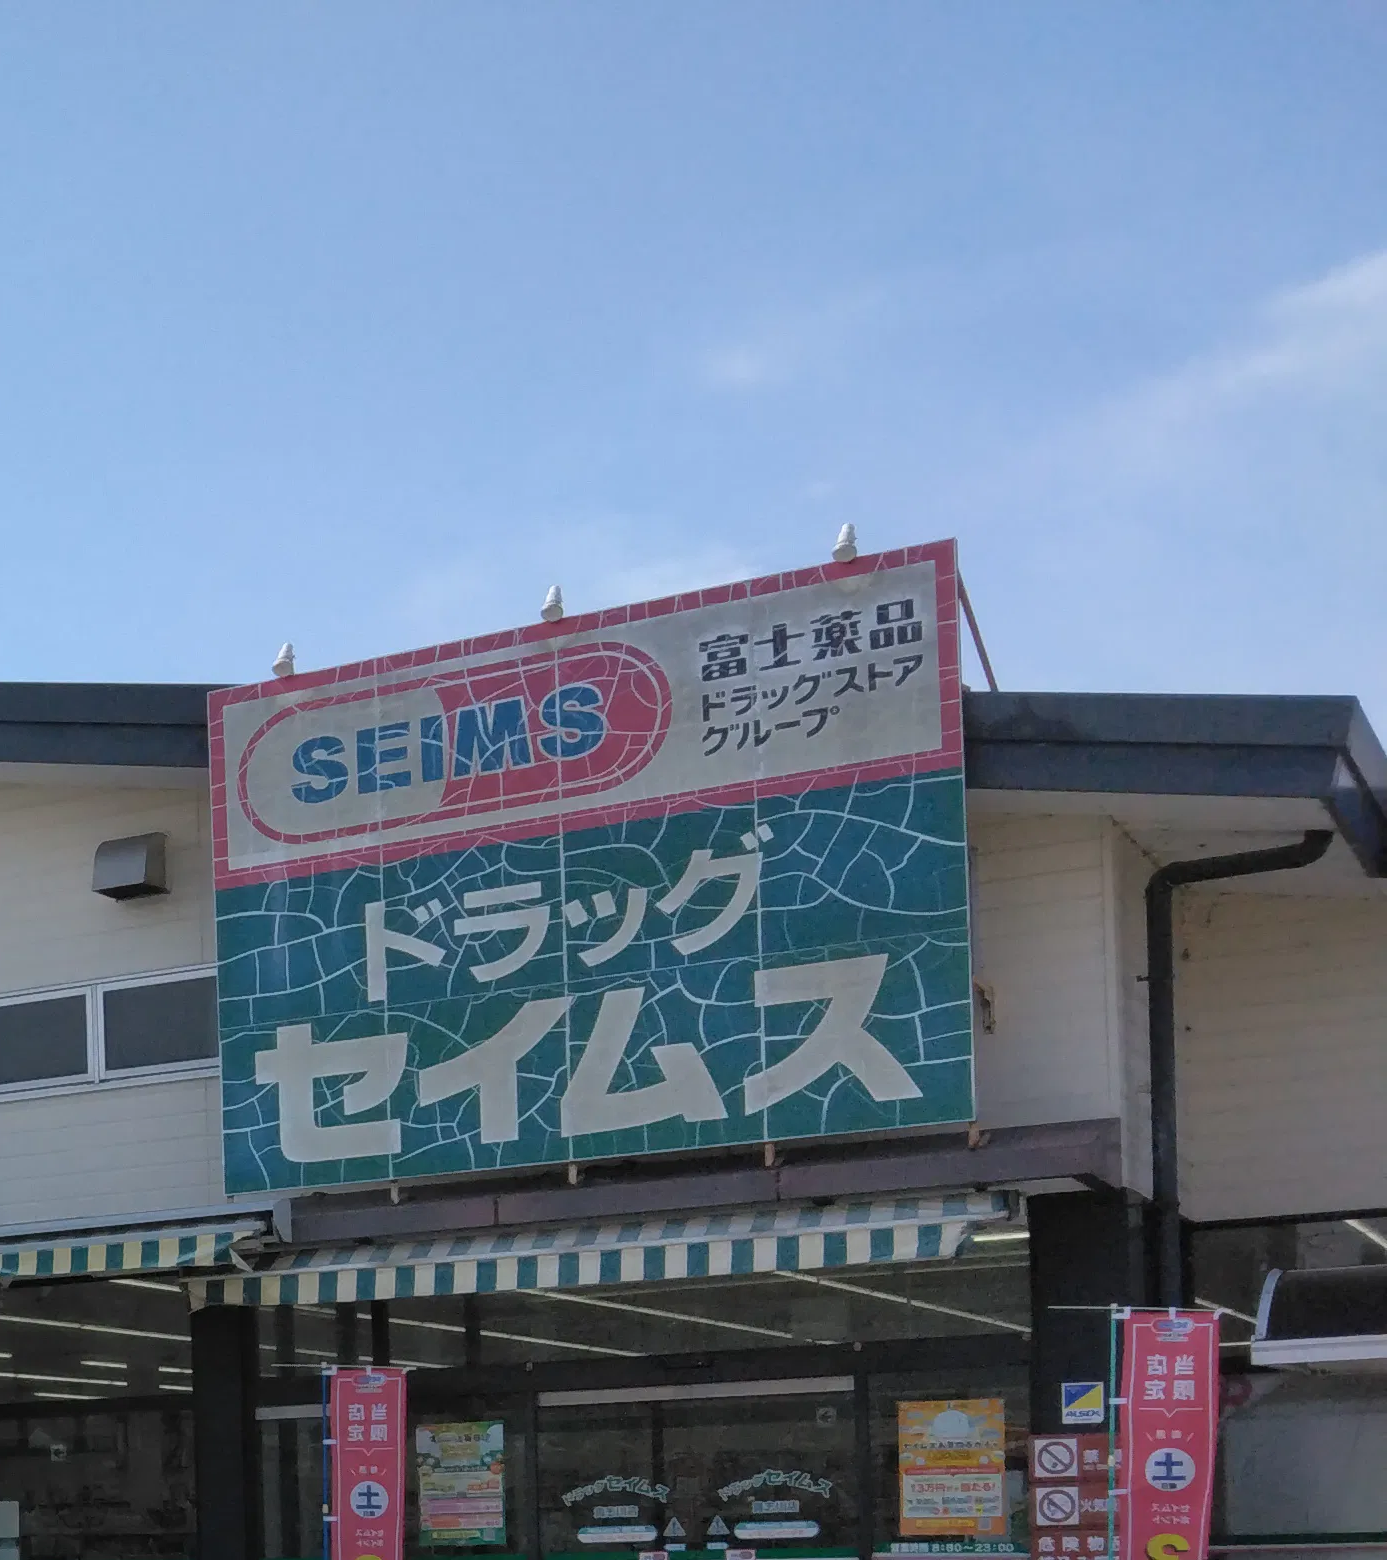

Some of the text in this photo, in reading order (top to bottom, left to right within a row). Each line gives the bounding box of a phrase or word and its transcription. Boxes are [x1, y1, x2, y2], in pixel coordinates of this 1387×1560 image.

[699, 599, 923, 682] 富士薬品
[702, 654, 924, 722] ドラッグストア
[290, 682, 610, 805] SEIMS
[702, 705, 841, 757] グループ
[366, 823, 774, 1002] ドラッグ
[254, 953, 924, 1163] セイムス
